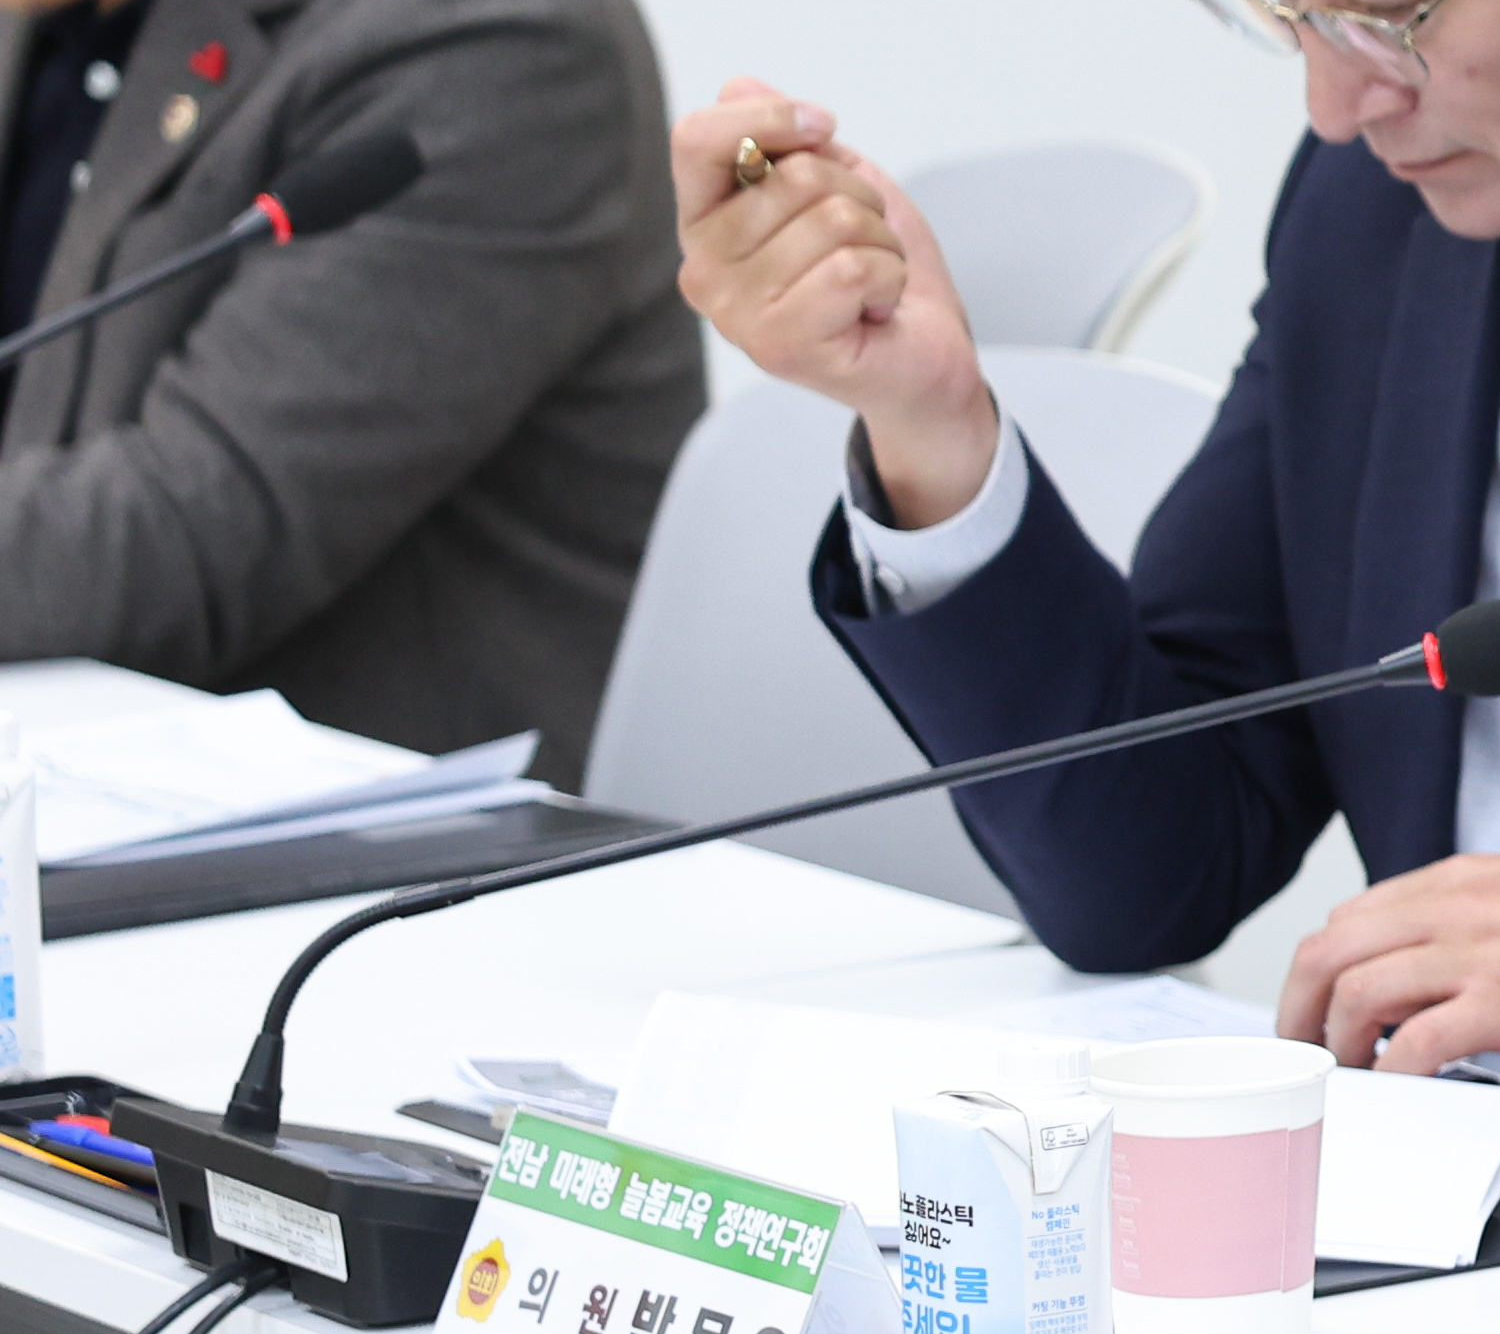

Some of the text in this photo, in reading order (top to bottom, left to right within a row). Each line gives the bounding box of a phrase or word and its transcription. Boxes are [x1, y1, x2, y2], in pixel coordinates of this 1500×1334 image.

[498, 1135, 830, 1276] 전남 미래형 늘봄교육 정책연구회
[900, 1190, 974, 1227] 노플라스틱
[1046, 1203, 1080, 1219] 플라스틱
[901, 1253, 989, 1304] 끗한 물
